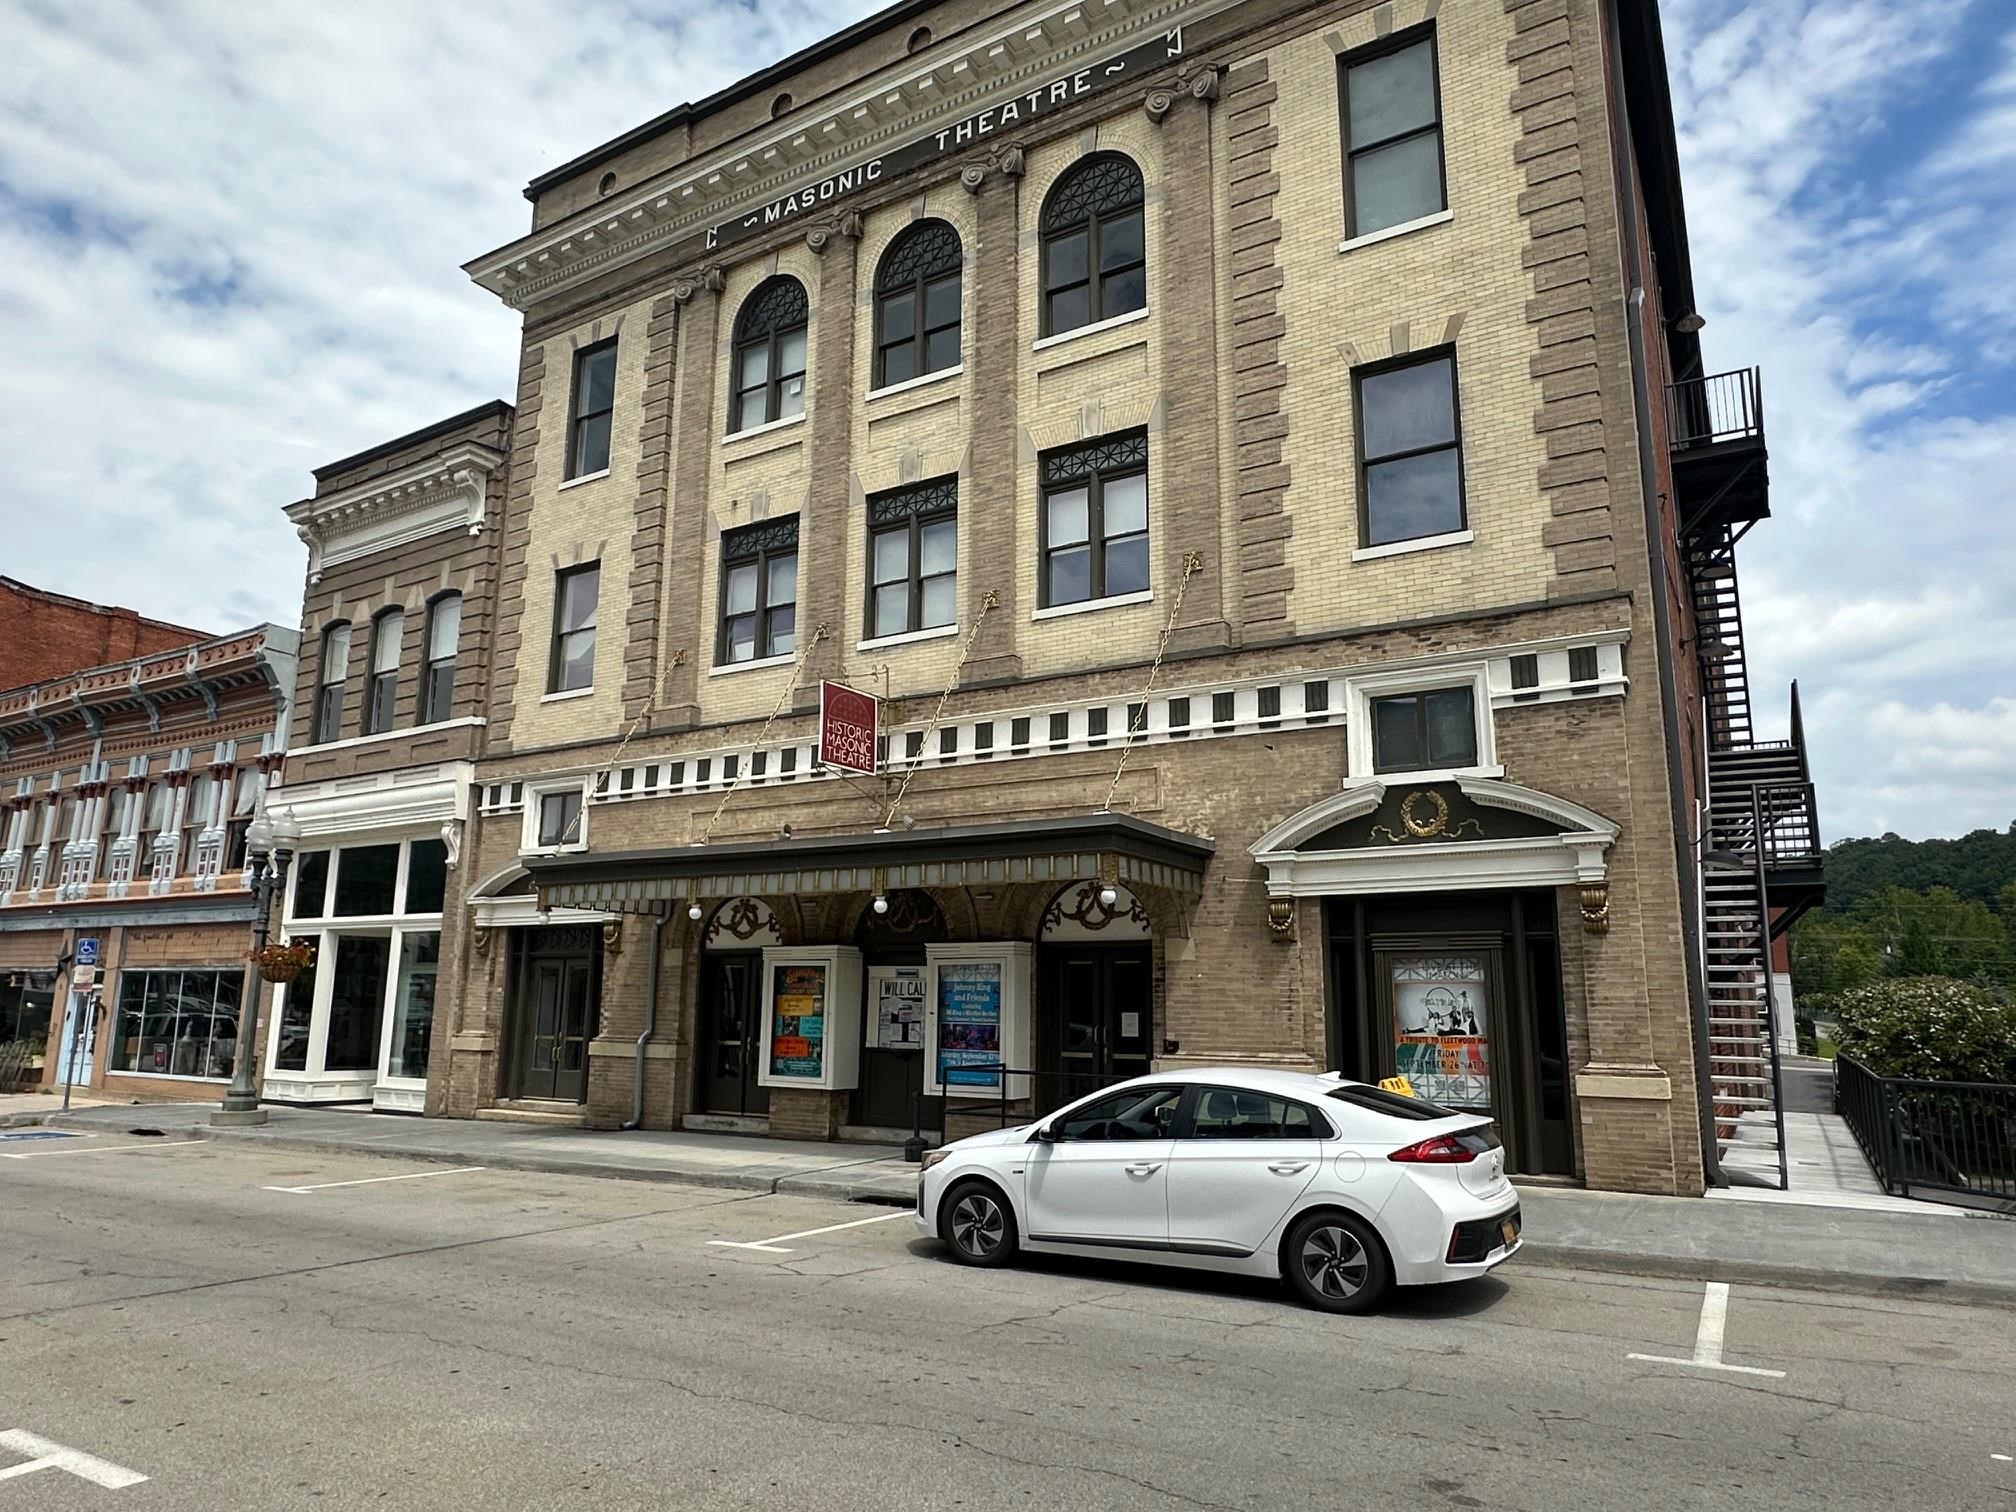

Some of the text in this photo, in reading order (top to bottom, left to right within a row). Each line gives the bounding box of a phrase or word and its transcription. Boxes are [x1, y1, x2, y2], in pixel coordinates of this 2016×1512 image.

[764, 70, 1092, 223] MASONIC THEATRE
[826, 718, 872, 743] HISTORIC
[826, 732, 872, 757] MASONIC
[826, 745, 872, 770] THEATRE
[884, 981, 905, 996] WILL
[1431, 1036, 1439, 1044] TO
[1441, 1037, 1476, 1045] FLEETWOOD
[1433, 1048, 1459, 1059] FRIDAY
[1402, 1059, 1446, 1070] SEPTEMBER
[1467, 1061, 1477, 1070] AT
